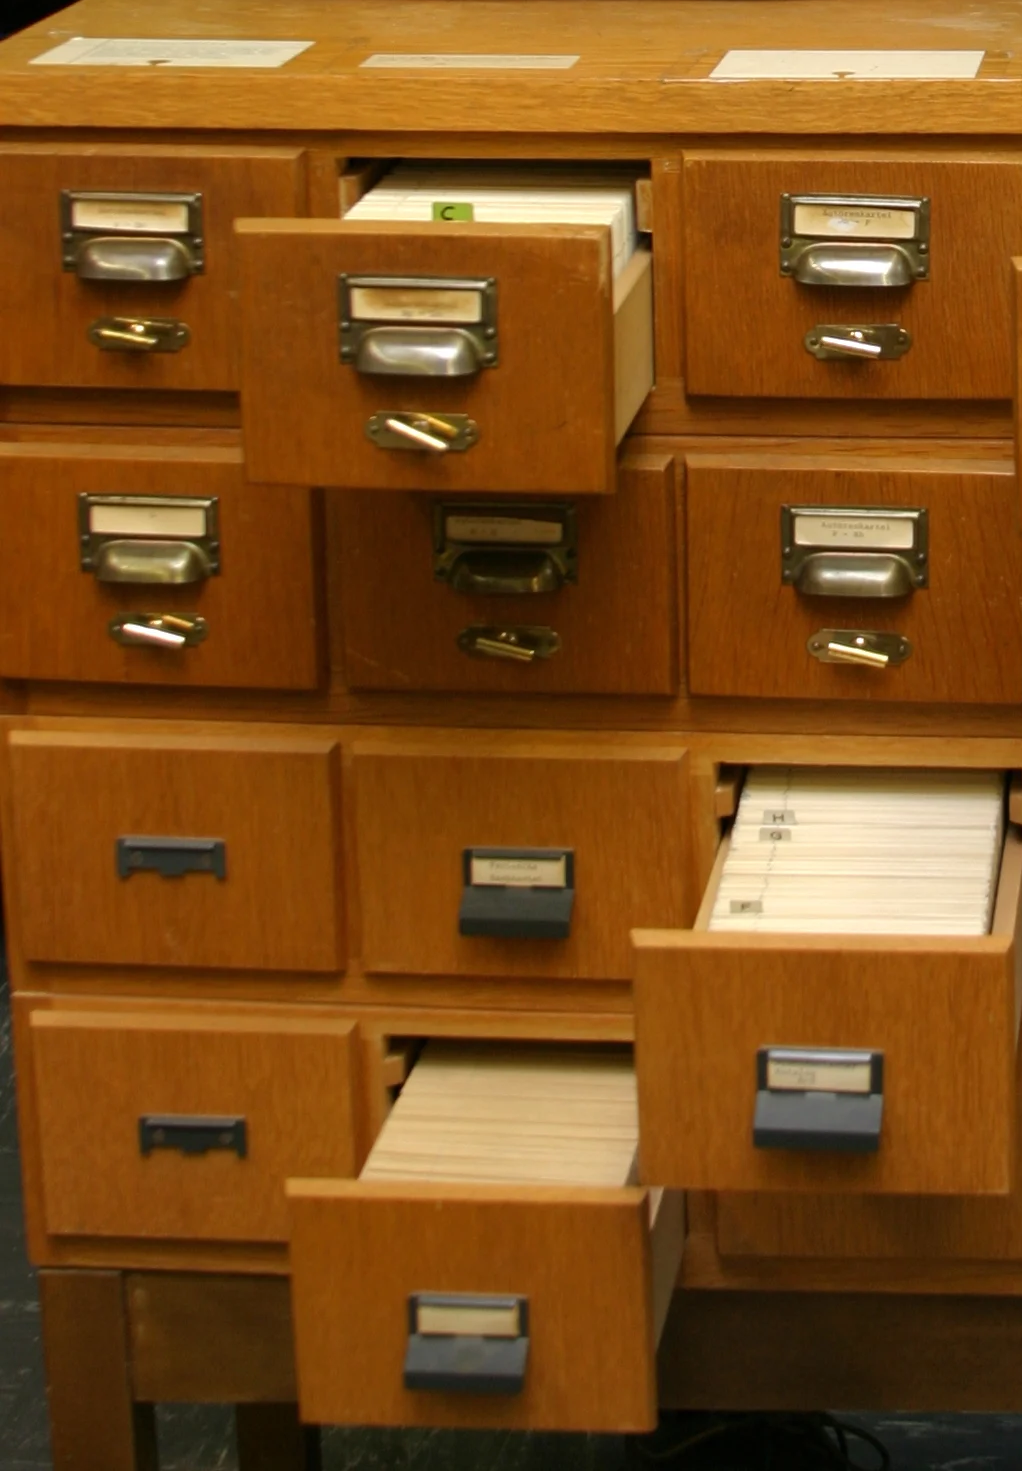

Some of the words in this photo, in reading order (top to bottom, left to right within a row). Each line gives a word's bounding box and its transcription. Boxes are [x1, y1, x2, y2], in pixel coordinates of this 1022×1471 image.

[440, 205, 455, 221] C
[821, 209, 892, 219] Autorenkartei
[821, 521, 891, 531] Autorenkartei
[772, 813, 785, 823] H
